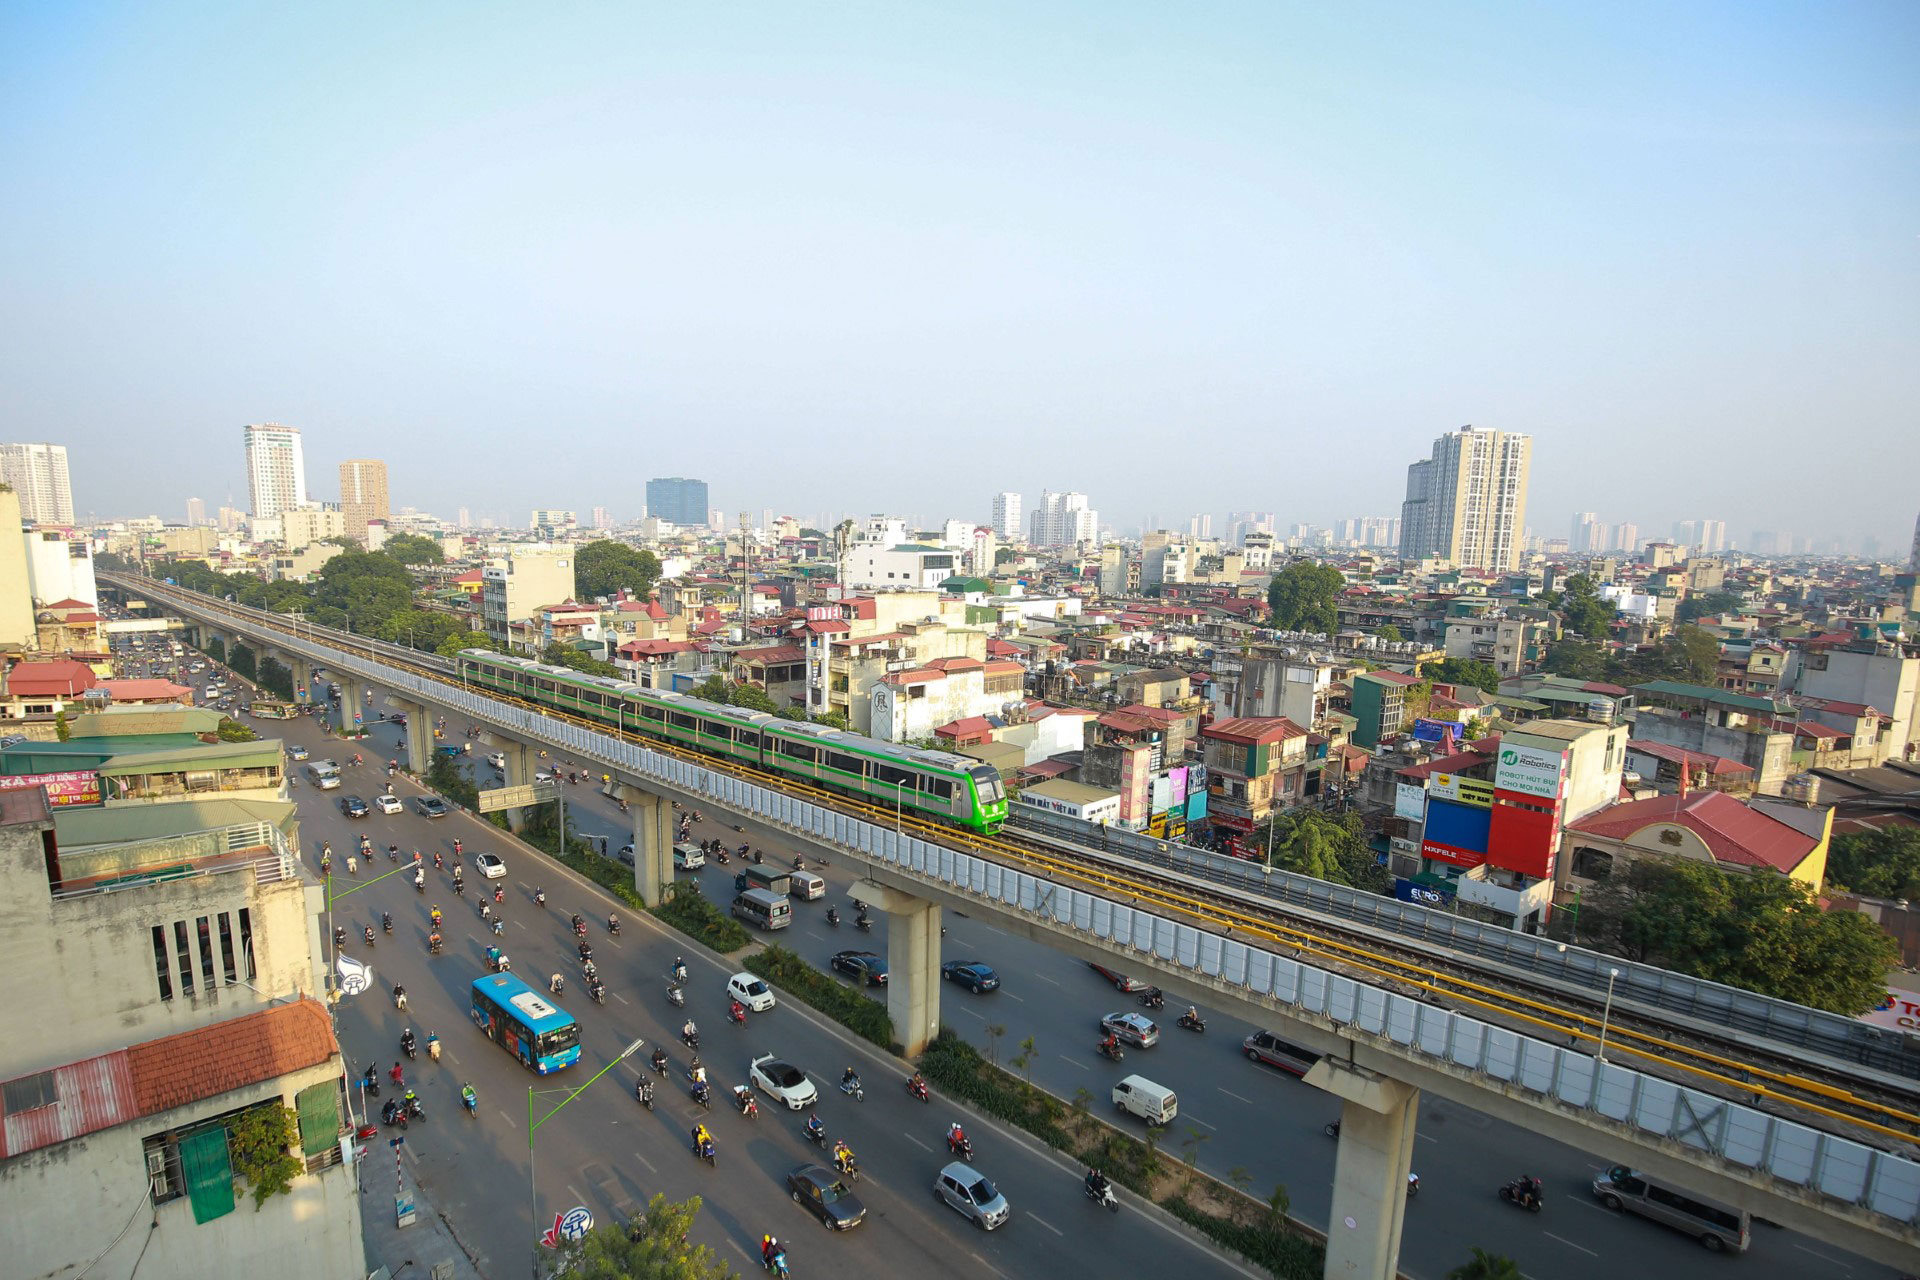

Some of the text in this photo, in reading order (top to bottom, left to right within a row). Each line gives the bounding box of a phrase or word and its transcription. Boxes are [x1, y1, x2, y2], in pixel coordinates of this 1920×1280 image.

[808, 607, 842, 620] HOTEL
[1519, 758, 1557, 770] Robotics
[1499, 770, 1525, 780] ROBOT
[1526, 774, 1541, 783] HÚT
[1502, 780, 1518, 788] CHO
[1411, 888, 1439, 902] EURO
